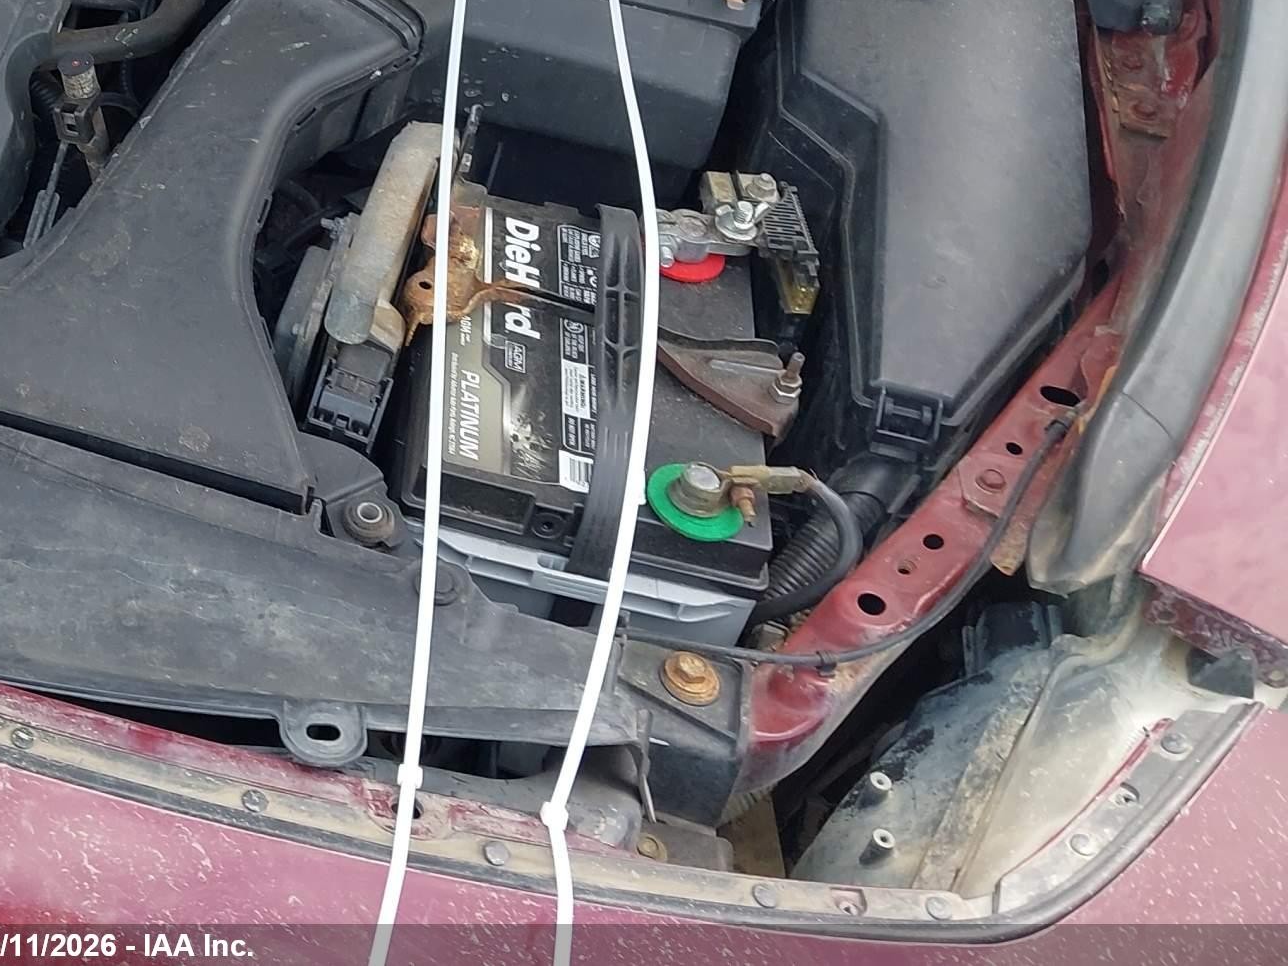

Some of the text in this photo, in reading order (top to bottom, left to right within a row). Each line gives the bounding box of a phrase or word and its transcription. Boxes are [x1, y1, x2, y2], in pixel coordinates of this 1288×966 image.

[505, 217, 540, 339] DieHrd
[514, 346, 522, 369] AGM
[459, 370, 480, 461] PLATINUM
